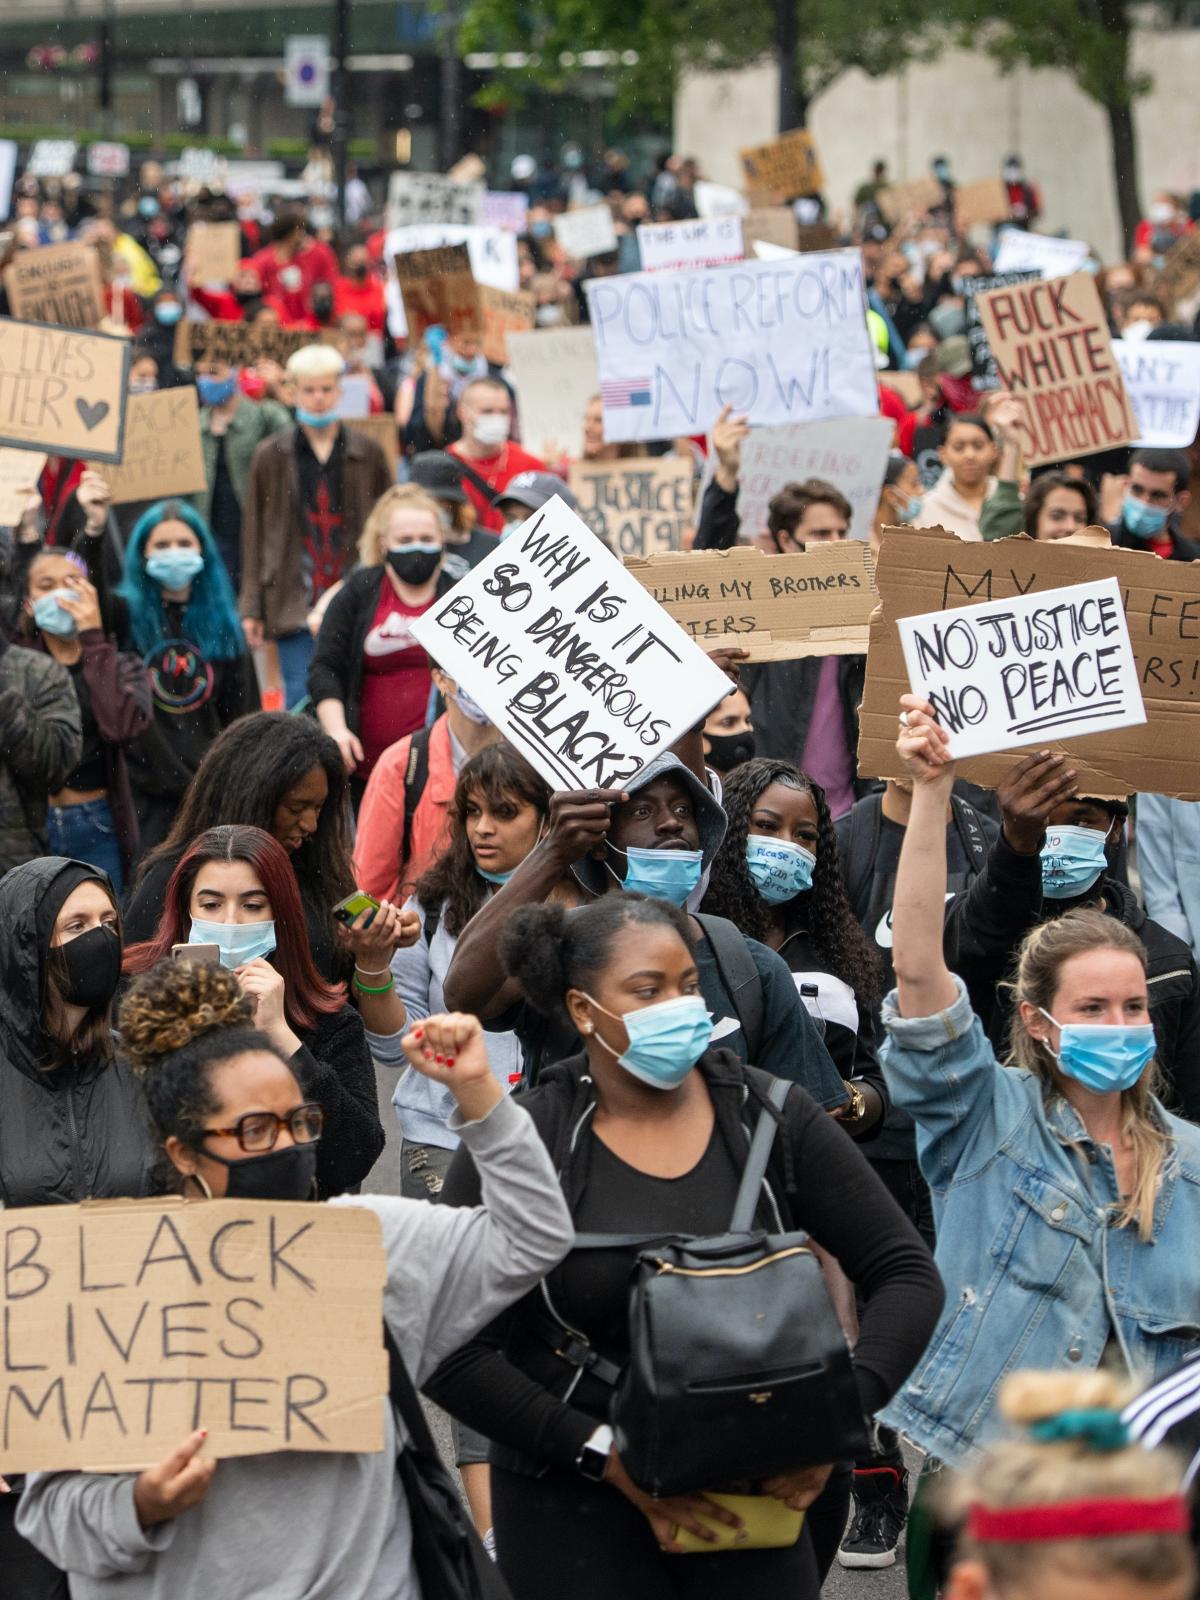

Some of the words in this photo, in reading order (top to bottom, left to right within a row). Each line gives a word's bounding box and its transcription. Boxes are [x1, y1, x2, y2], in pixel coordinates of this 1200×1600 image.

[593, 276, 720, 347] POLICE
[730, 260, 861, 334] REFORM
[988, 280, 1084, 341] FUCK
[19, 328, 97, 383] LIVES
[653, 346, 831, 428] NOW!
[995, 326, 1111, 392] WHITE
[129, 395, 191, 435] ACK
[1013, 376, 1132, 460] SUPREMACY
[520, 513, 591, 592] WHY
[575, 580, 628, 623] IS
[611, 623, 683, 665] IT
[719, 578, 753, 601] MY
[942, 564, 1037, 610] MY
[482, 562, 533, 613] SO
[524, 606, 672, 746] DANGEROUS
[678, 614, 757, 642] TERS
[912, 617, 978, 681] NO
[975, 596, 1123, 658] JUSTICE
[435, 594, 523, 686] BEING
[509, 669, 645, 790] BLACK?
[927, 684, 988, 735] NO
[999, 644, 1124, 721] PEACE
[967, 822, 984, 854] AIR
[4, 1213, 317, 1300] BLACK
[4, 1296, 265, 1372] LIVES
[2, 1371, 330, 1451] MATTER
